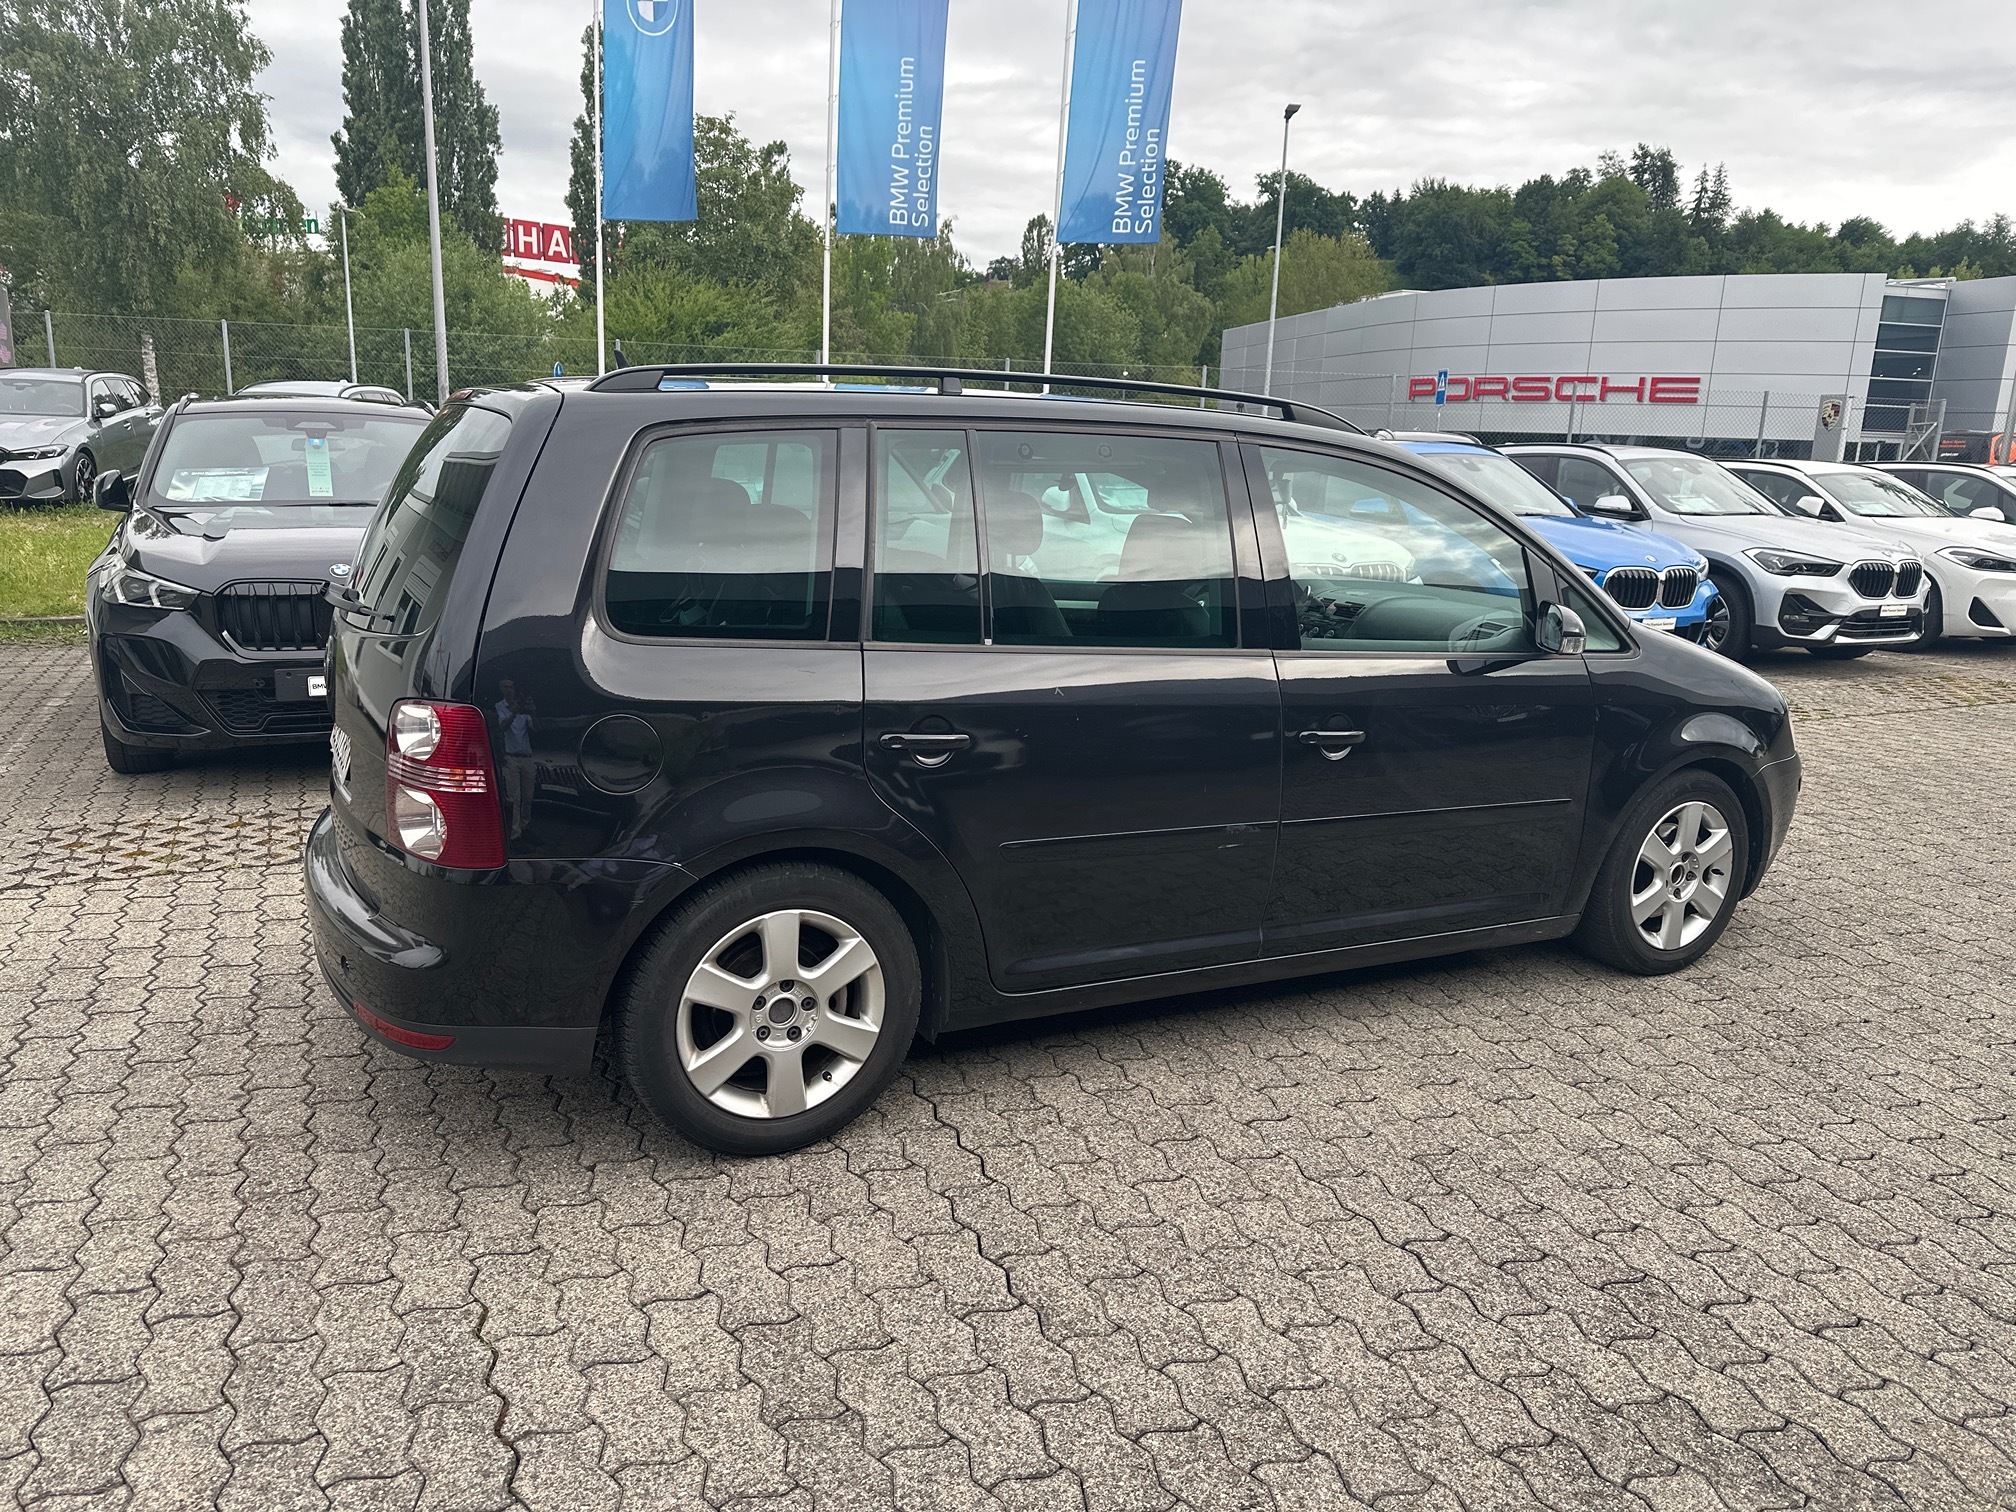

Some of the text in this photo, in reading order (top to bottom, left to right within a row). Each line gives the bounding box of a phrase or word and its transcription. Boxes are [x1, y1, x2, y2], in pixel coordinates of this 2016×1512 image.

[889, 56, 915, 225] BMW Premium
[911, 125, 933, 228] Selection
[1111, 59, 1146, 234] BMW Premium
[1134, 128, 1161, 234] Selection
[502, 223, 569, 259] HA
[1408, 375, 1702, 404] PORSCHE
